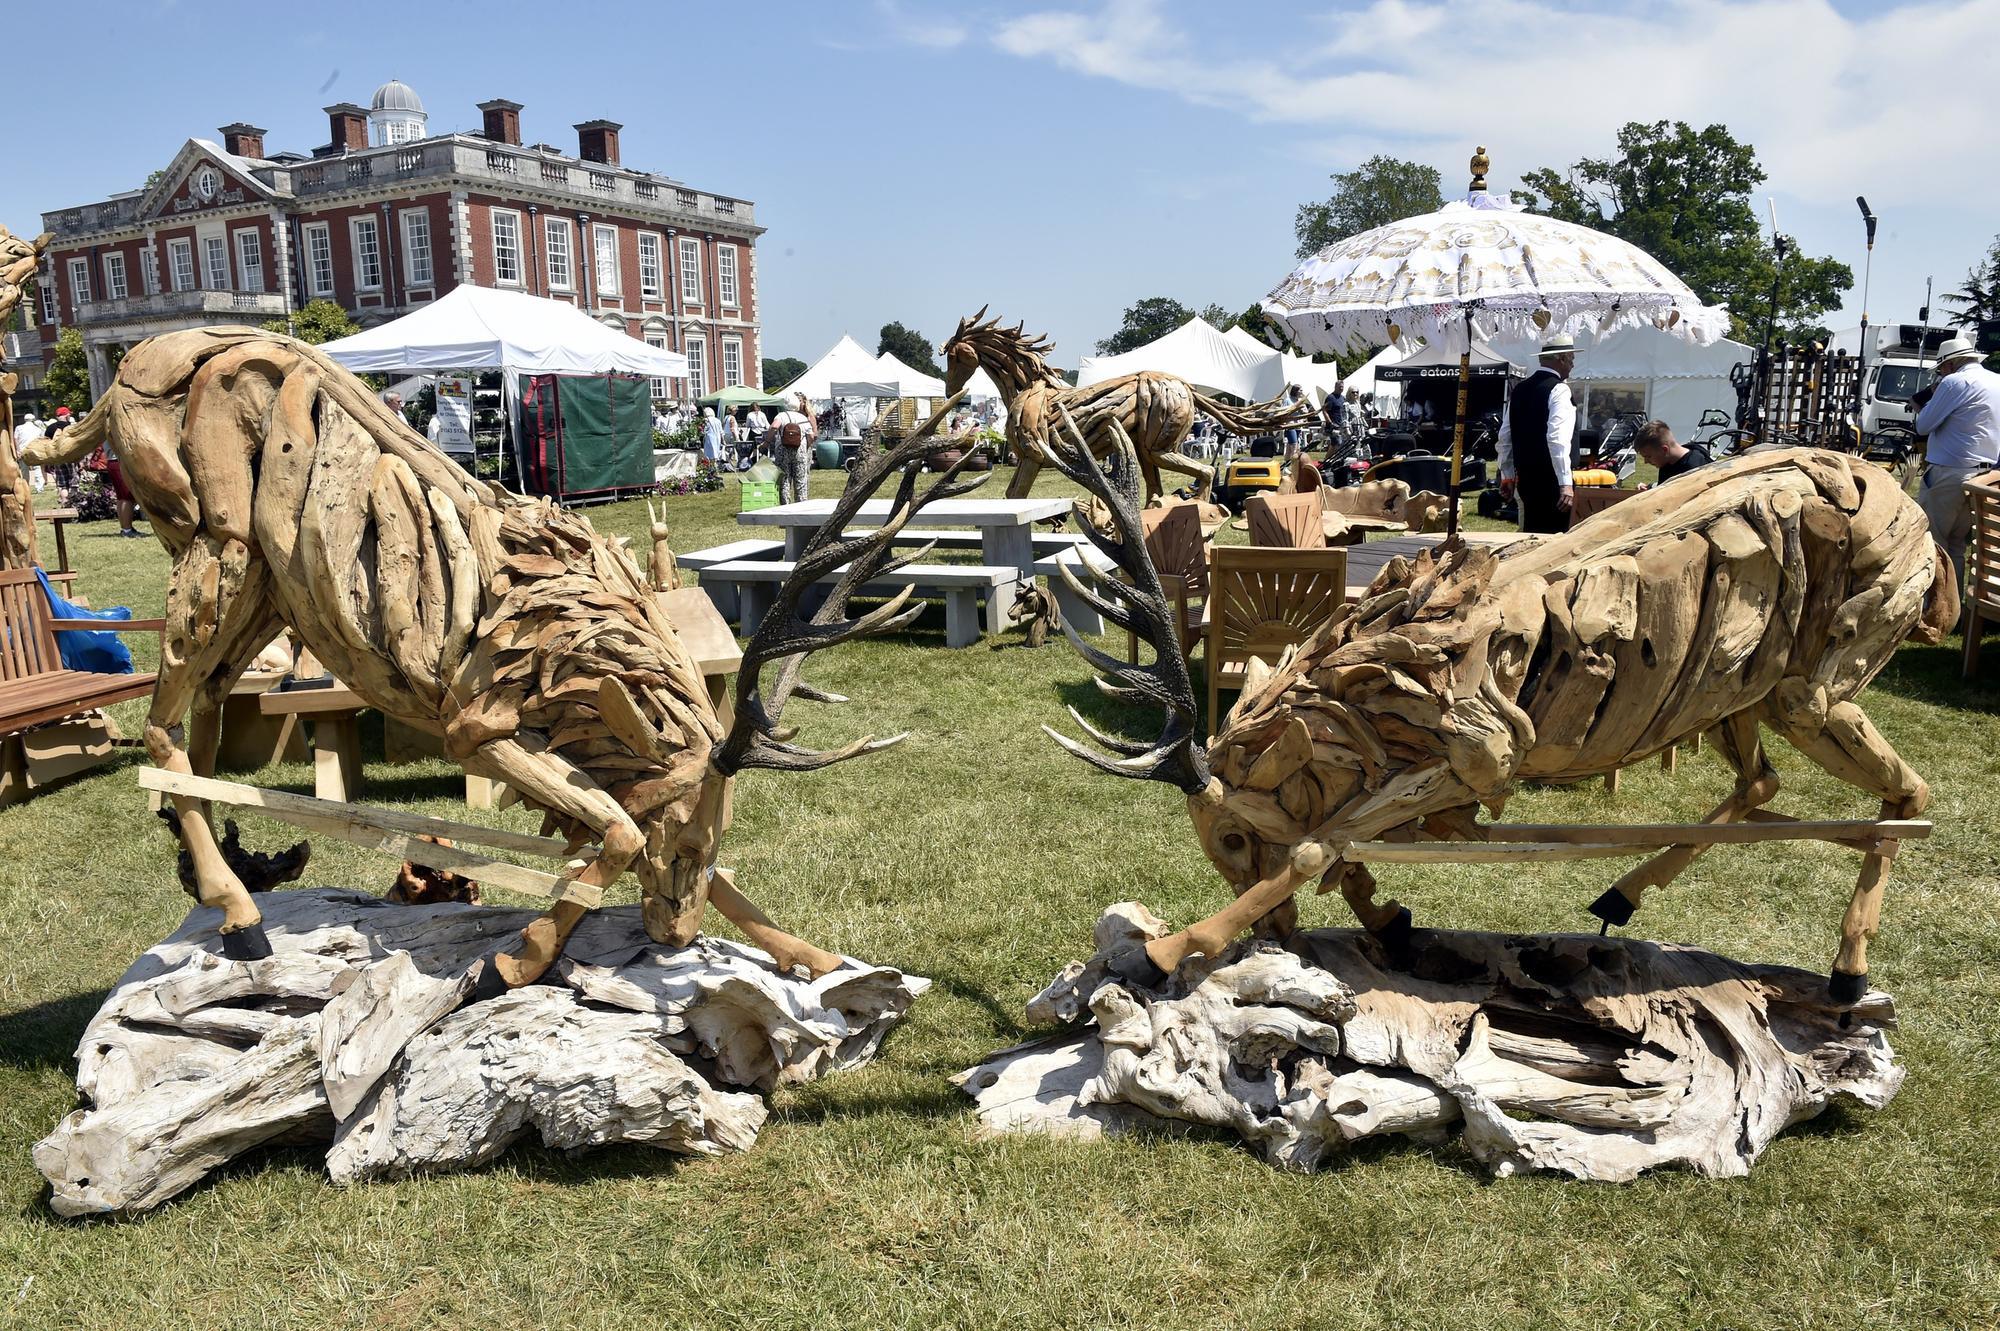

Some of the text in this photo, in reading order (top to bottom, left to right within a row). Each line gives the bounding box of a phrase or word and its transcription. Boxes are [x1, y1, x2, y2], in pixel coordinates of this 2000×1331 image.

[1384, 368, 1403, 377] cafe
[1420, 367, 1460, 377] eatons
[1479, 366, 1495, 375] bar
